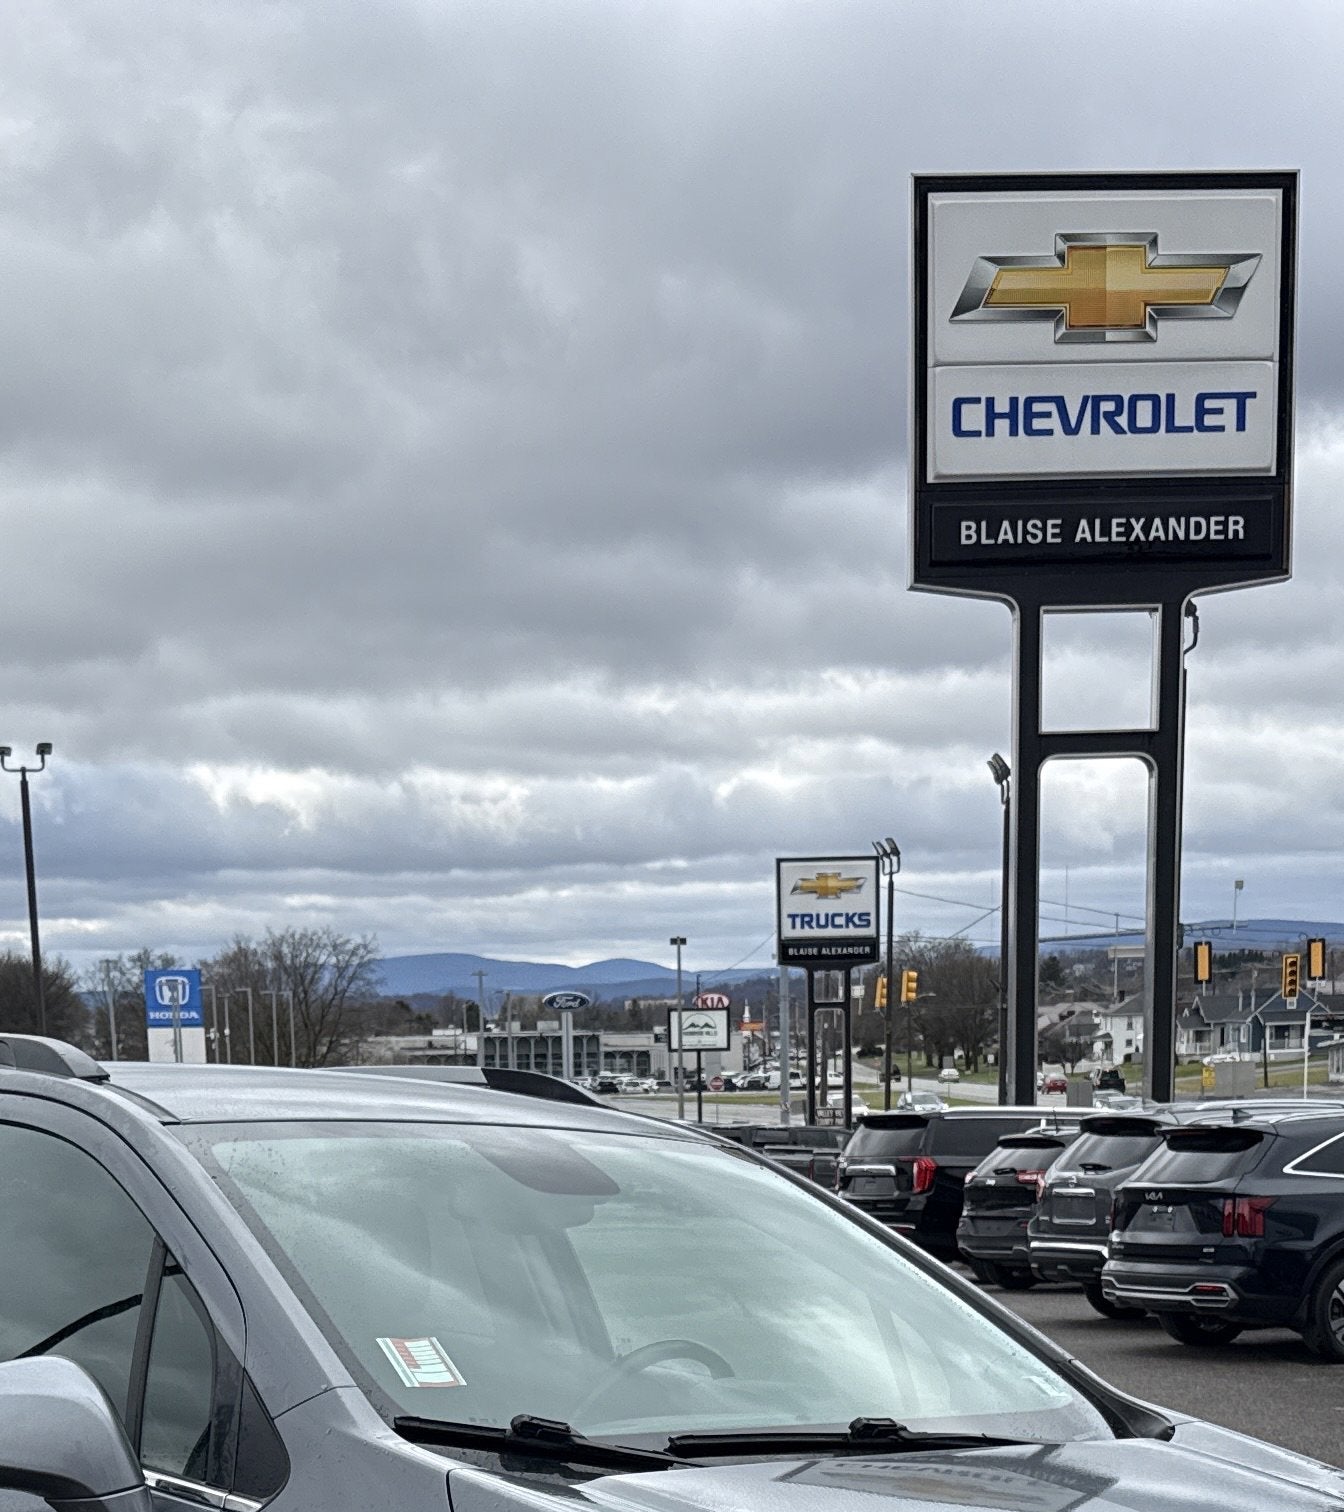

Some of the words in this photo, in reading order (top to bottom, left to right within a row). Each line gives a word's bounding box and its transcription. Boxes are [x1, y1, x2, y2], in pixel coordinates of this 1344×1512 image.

[952, 392, 1257, 437] CHEVROLET
[960, 519, 1062, 545] BLAISE
[1074, 516, 1245, 543] ALEXANDER
[787, 912, 871, 930] TRUCKS
[788, 947, 818, 956] BLAISE
[821, 946, 871, 955] ALEXANDER
[554, 996, 582, 1009] Ford
[701, 996, 726, 1009] KIA
